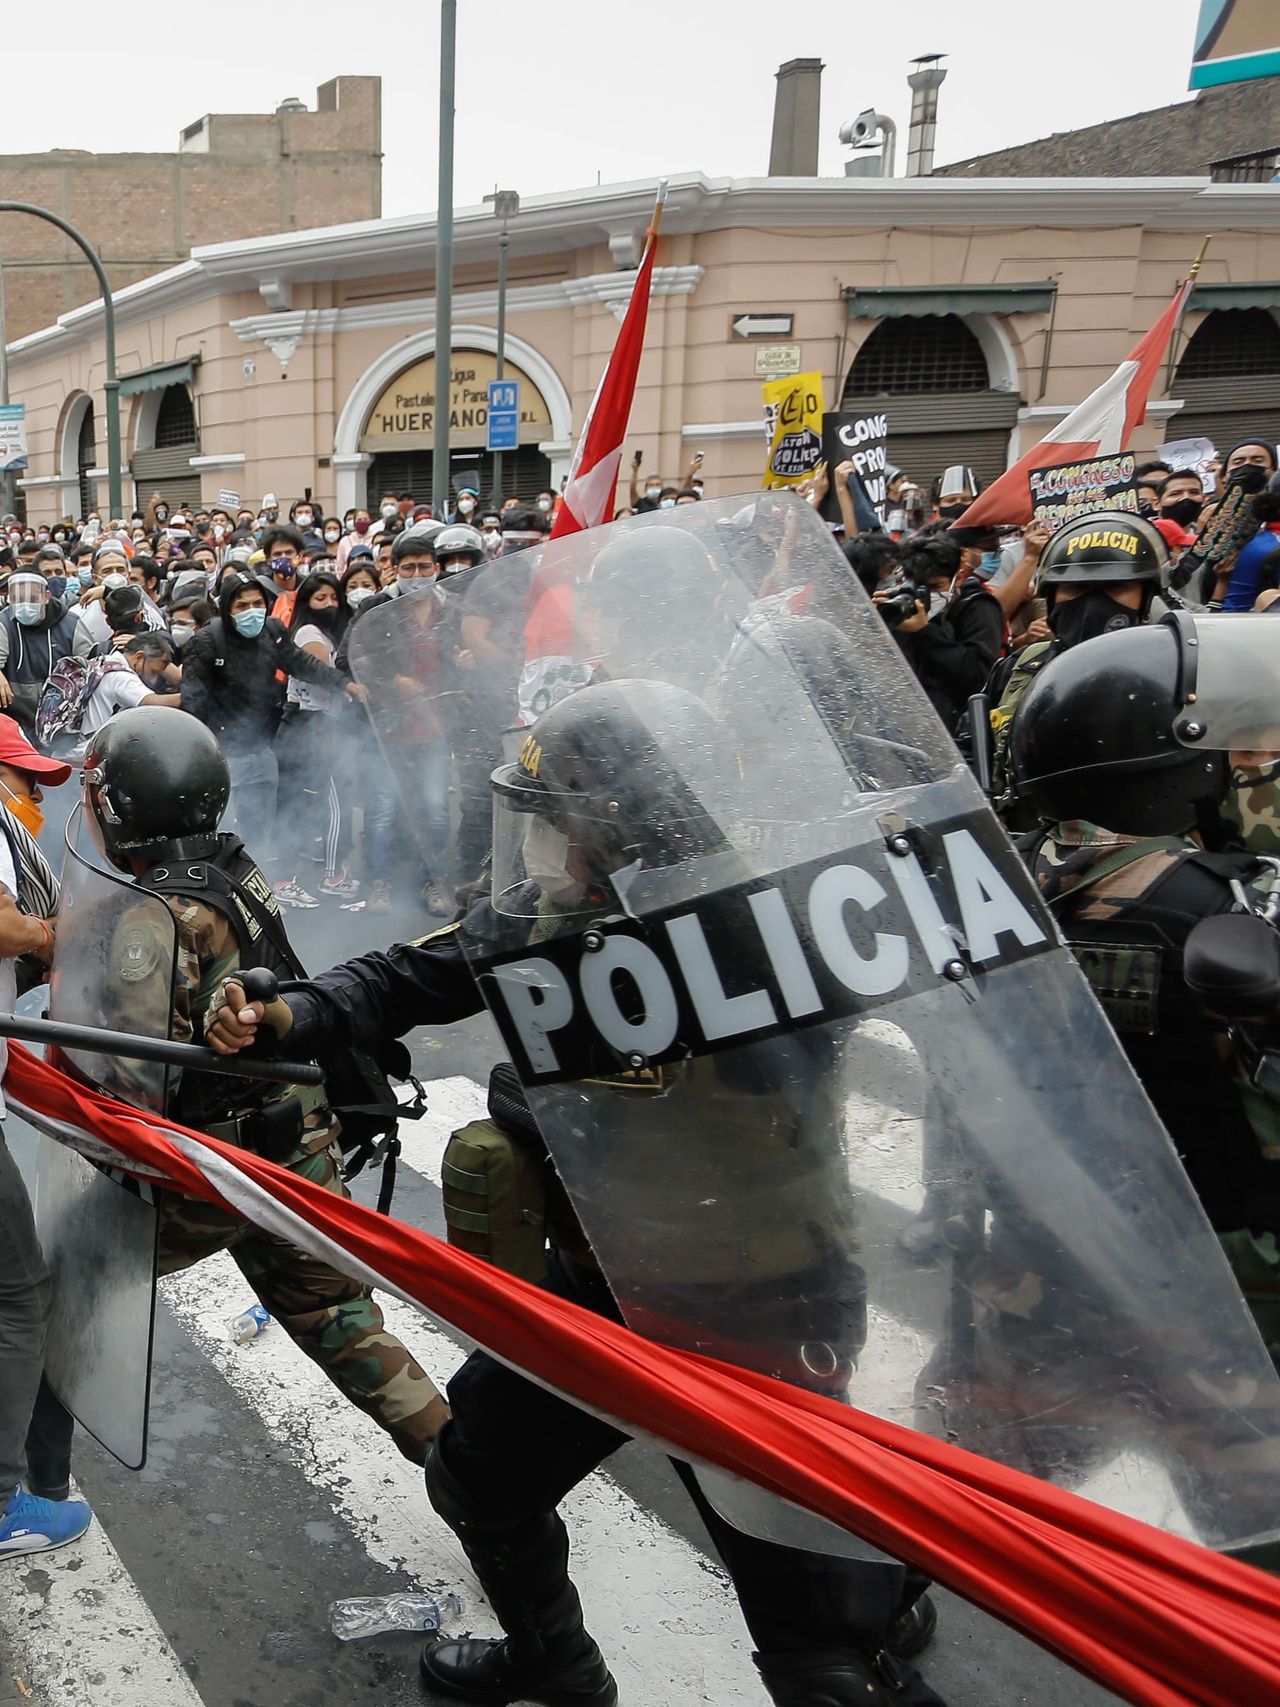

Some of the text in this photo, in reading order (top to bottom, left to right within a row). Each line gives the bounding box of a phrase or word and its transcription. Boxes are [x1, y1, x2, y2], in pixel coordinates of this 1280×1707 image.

[396, 392, 435, 408] Pastele
[452, 394, 459, 405] y
[1045, 455, 1136, 496] CONGRESO
[1086, 486, 1108, 501] ME
[1066, 531, 1140, 556] POLICIA
[492, 828, 1048, 1075] POLICIA
